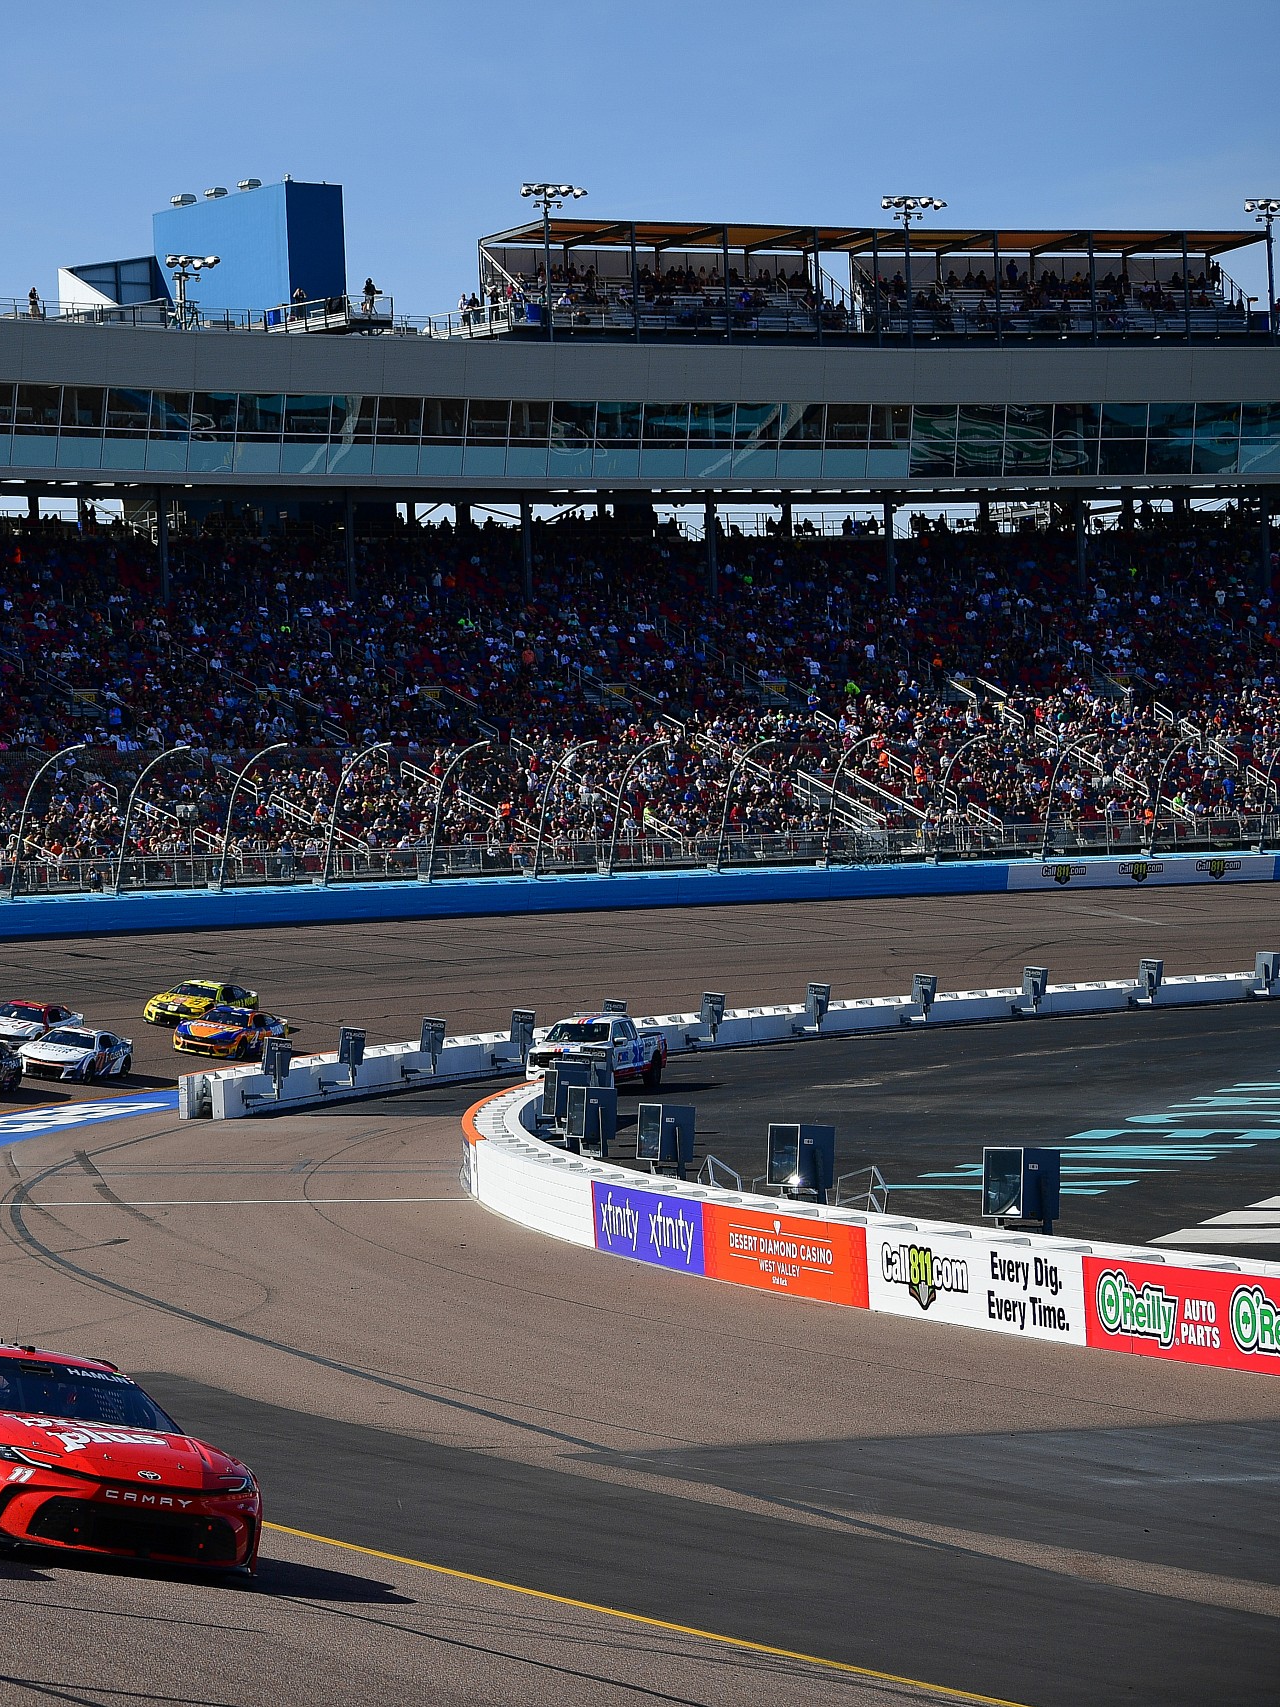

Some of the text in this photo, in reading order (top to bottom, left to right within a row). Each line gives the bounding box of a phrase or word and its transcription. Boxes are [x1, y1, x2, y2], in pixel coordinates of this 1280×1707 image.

[1042, 864, 1086, 877] Call811.com
[1119, 862, 1163, 875] Call811.com
[1196, 859, 1241, 872] Call811.com
[250, 1031, 259, 1049] 4
[600, 1191, 639, 1252] xfinity
[648, 1201, 695, 1265] xfinity
[729, 1232, 833, 1265] DESERT DIAMOND CASINO
[758, 1258, 800, 1278] WEST VALLEY
[881, 1241, 969, 1293] Call811.com
[990, 1251, 1063, 1296] Every Dig.
[987, 1290, 1070, 1332] Every Time.
[1098, 1274, 1175, 1344] O'Reilly
[1184, 1299, 1216, 1323] AUTO
[1181, 1322, 1221, 1349] PARTS
[66, 1367, 130, 1384] HAMLIN
[46, 1426, 169, 1453] plus
[6, 1466, 37, 1483] 11
[105, 1489, 193, 1508] CAMRY
